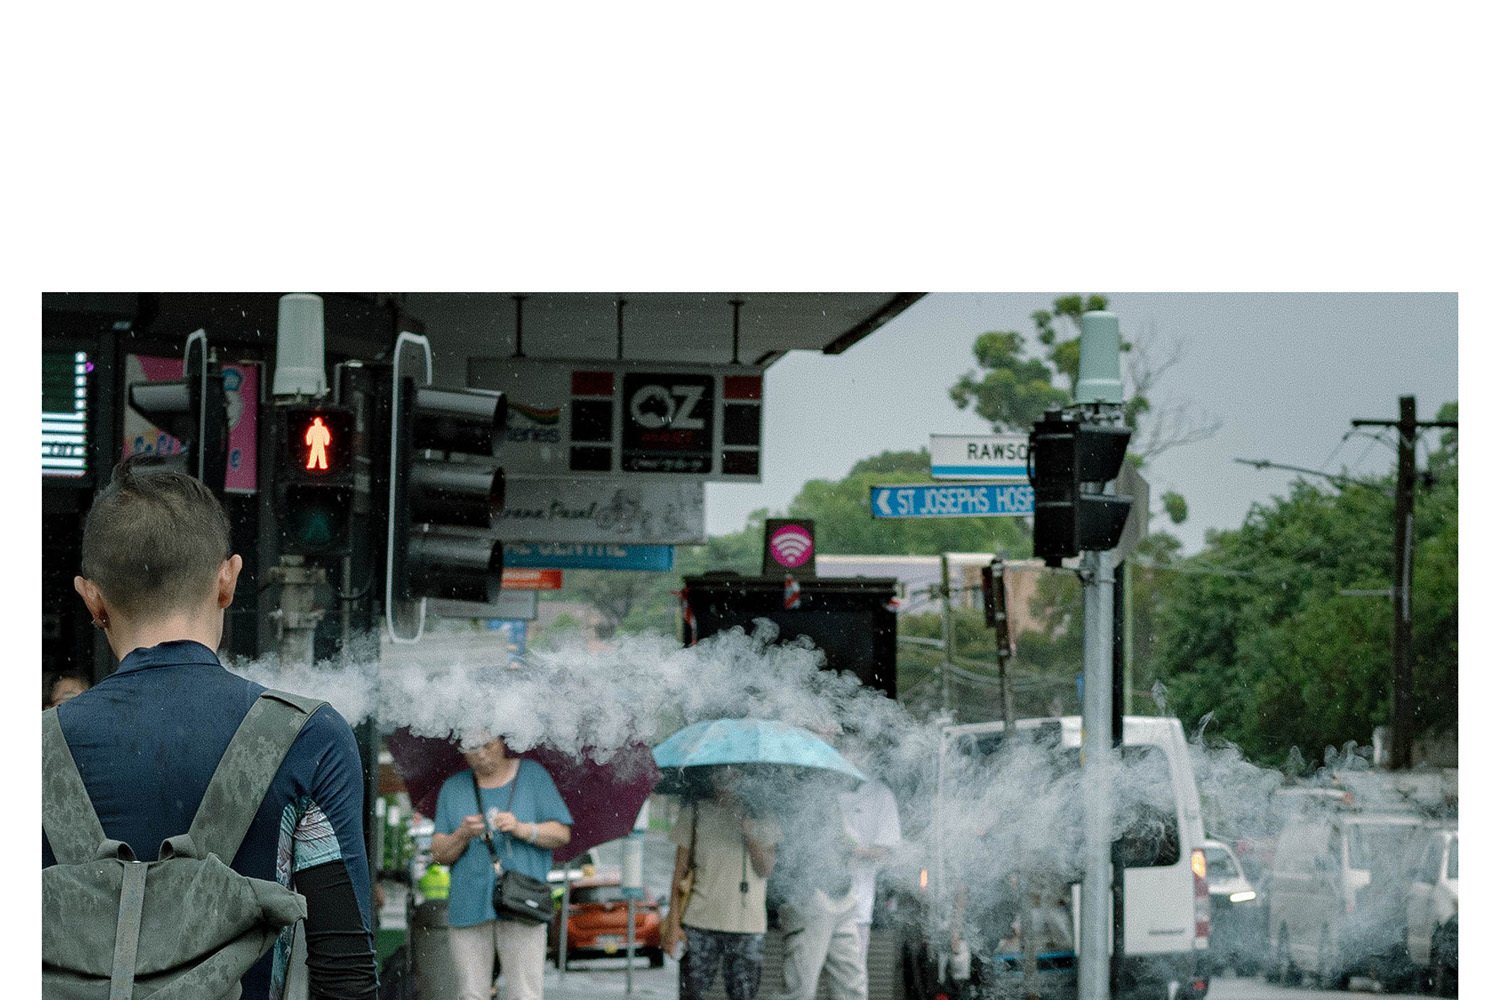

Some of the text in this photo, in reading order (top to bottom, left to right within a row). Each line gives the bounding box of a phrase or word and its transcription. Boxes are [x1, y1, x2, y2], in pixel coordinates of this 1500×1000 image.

[629, 384, 706, 430] OZ
[967, 442, 1029, 460] RAWSO
[897, 486, 1035, 514] ST JOSEPHS HOSP
